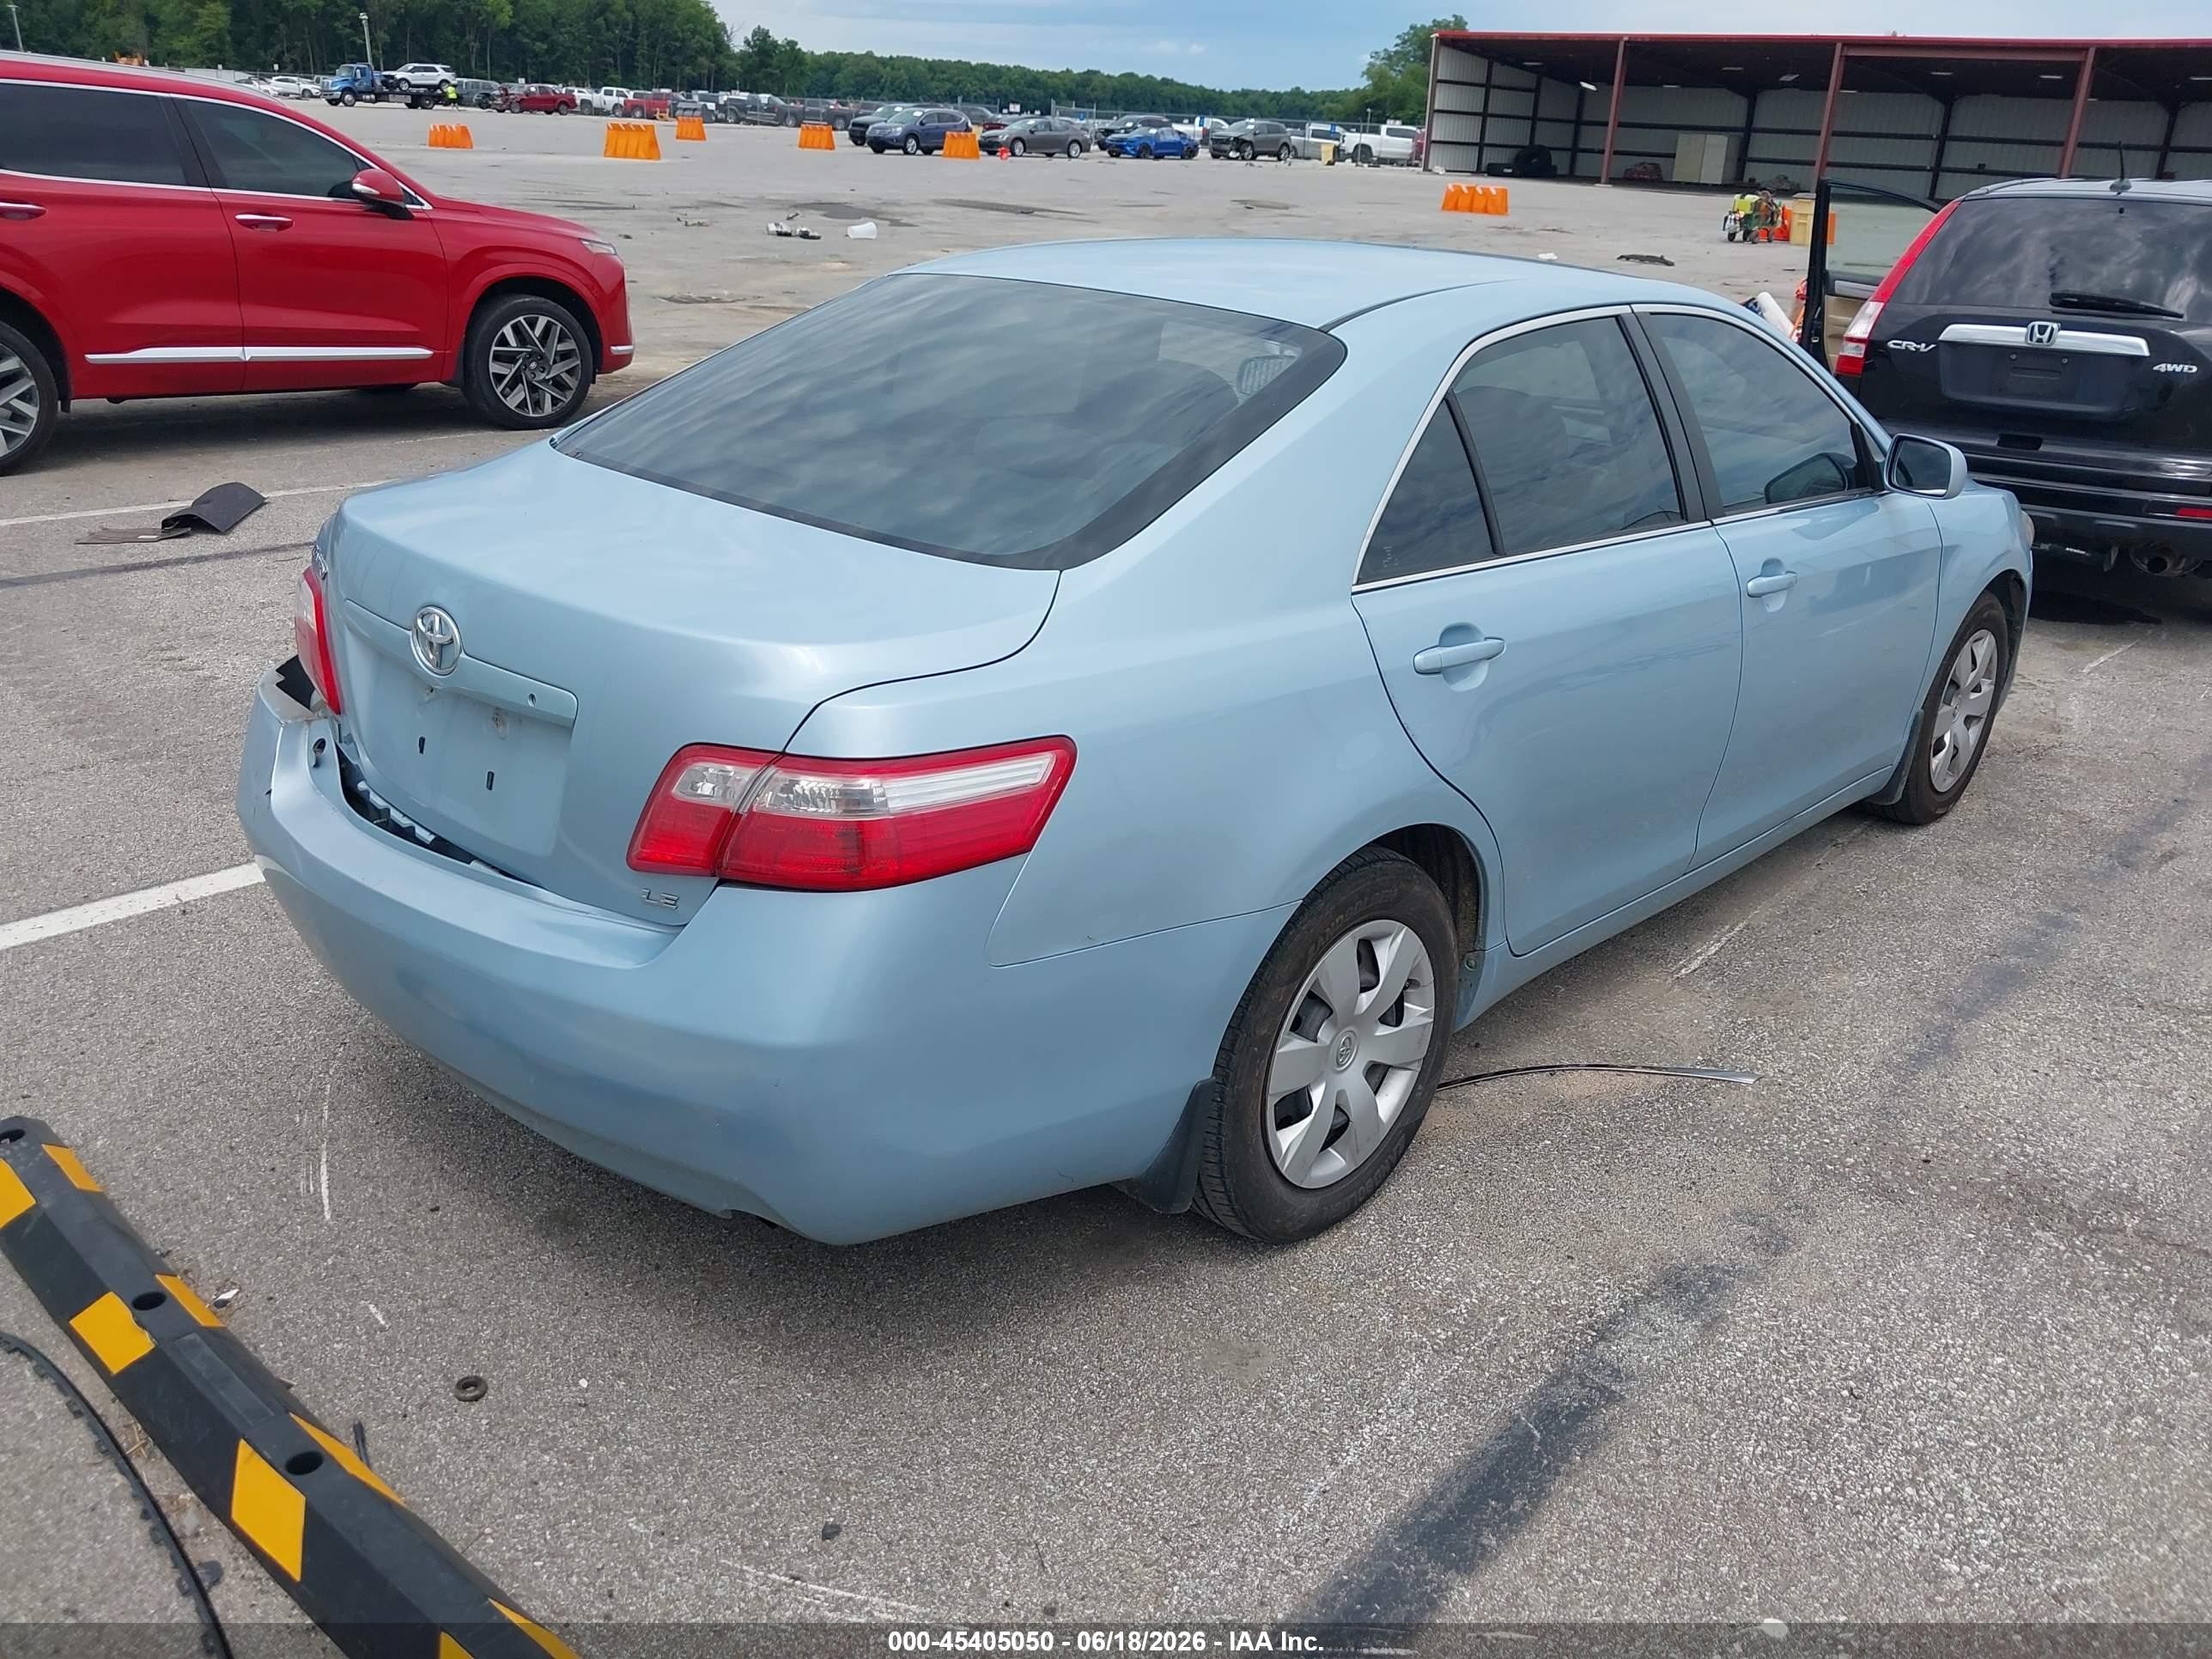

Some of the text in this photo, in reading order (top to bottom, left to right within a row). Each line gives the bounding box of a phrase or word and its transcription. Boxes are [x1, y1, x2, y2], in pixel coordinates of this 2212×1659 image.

[1887, 340, 1936, 352] CR-V
[2153, 363, 2198, 373] 4WD
[641, 888, 680, 909] LE
